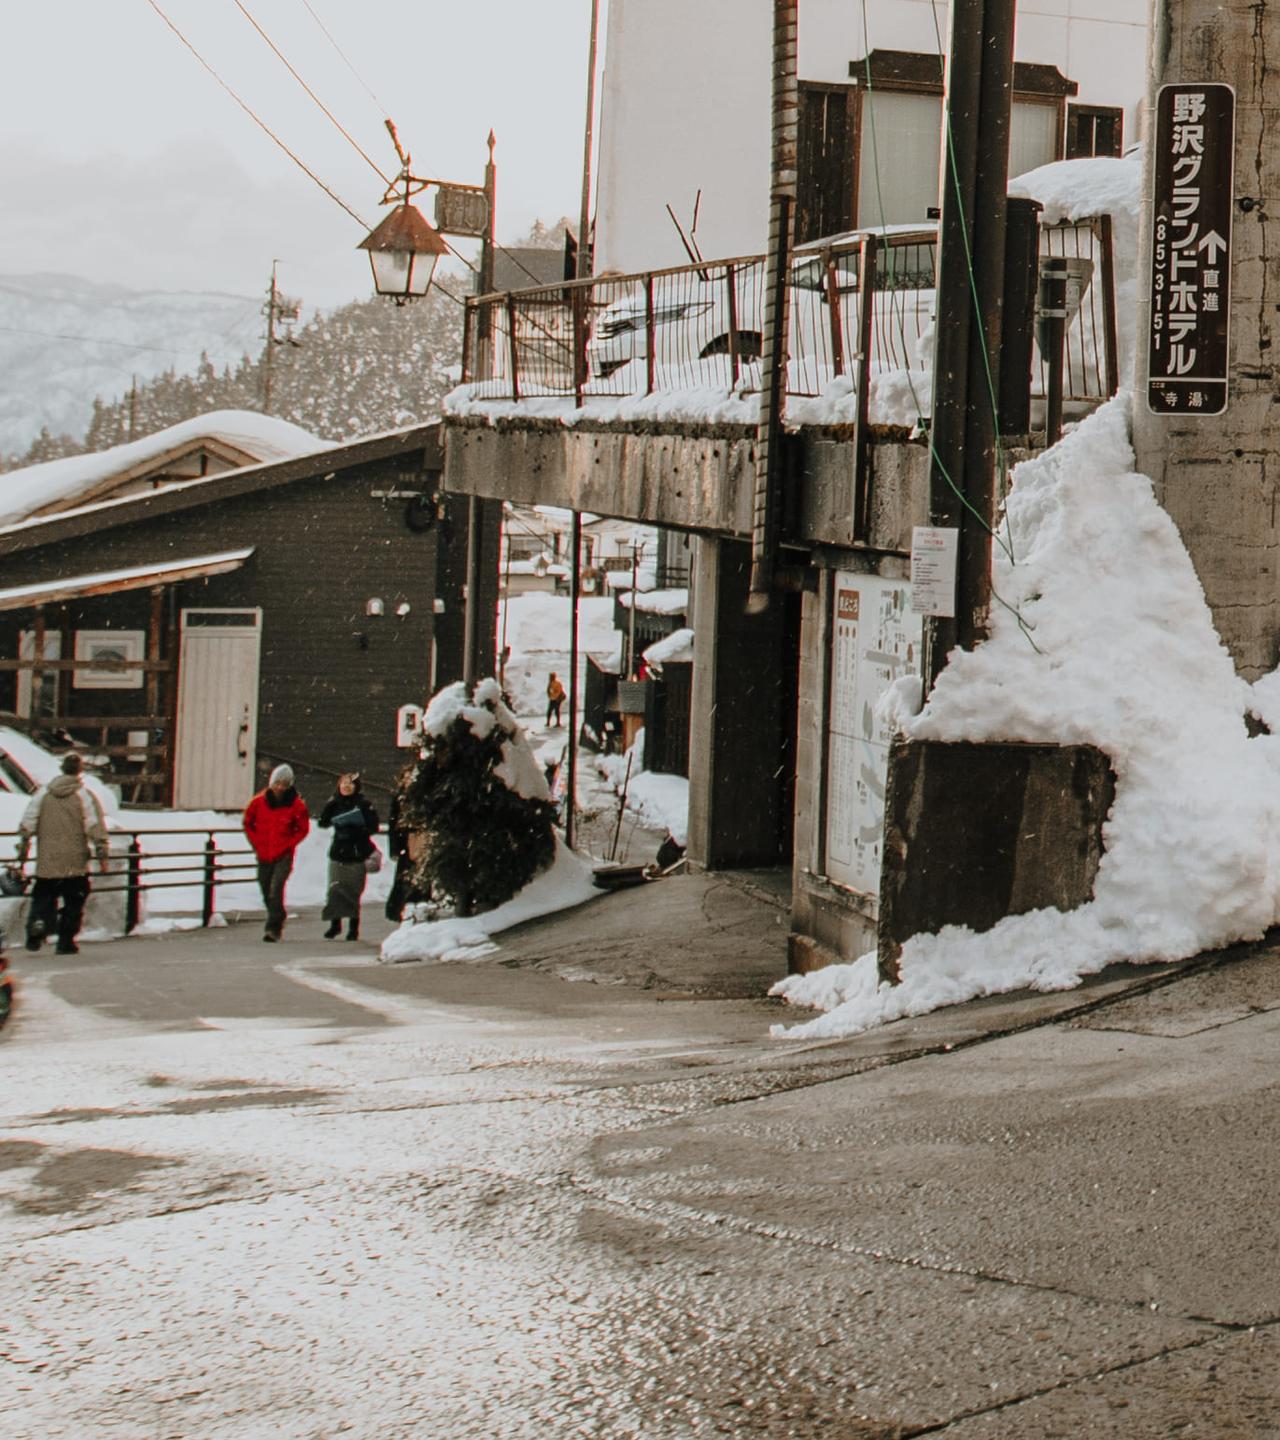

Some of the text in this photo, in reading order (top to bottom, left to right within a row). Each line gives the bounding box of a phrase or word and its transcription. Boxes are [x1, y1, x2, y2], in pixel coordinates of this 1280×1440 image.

[1167, 93, 1206, 375] 野沢グランドホテル
[1202, 269, 1220, 312] 直進
